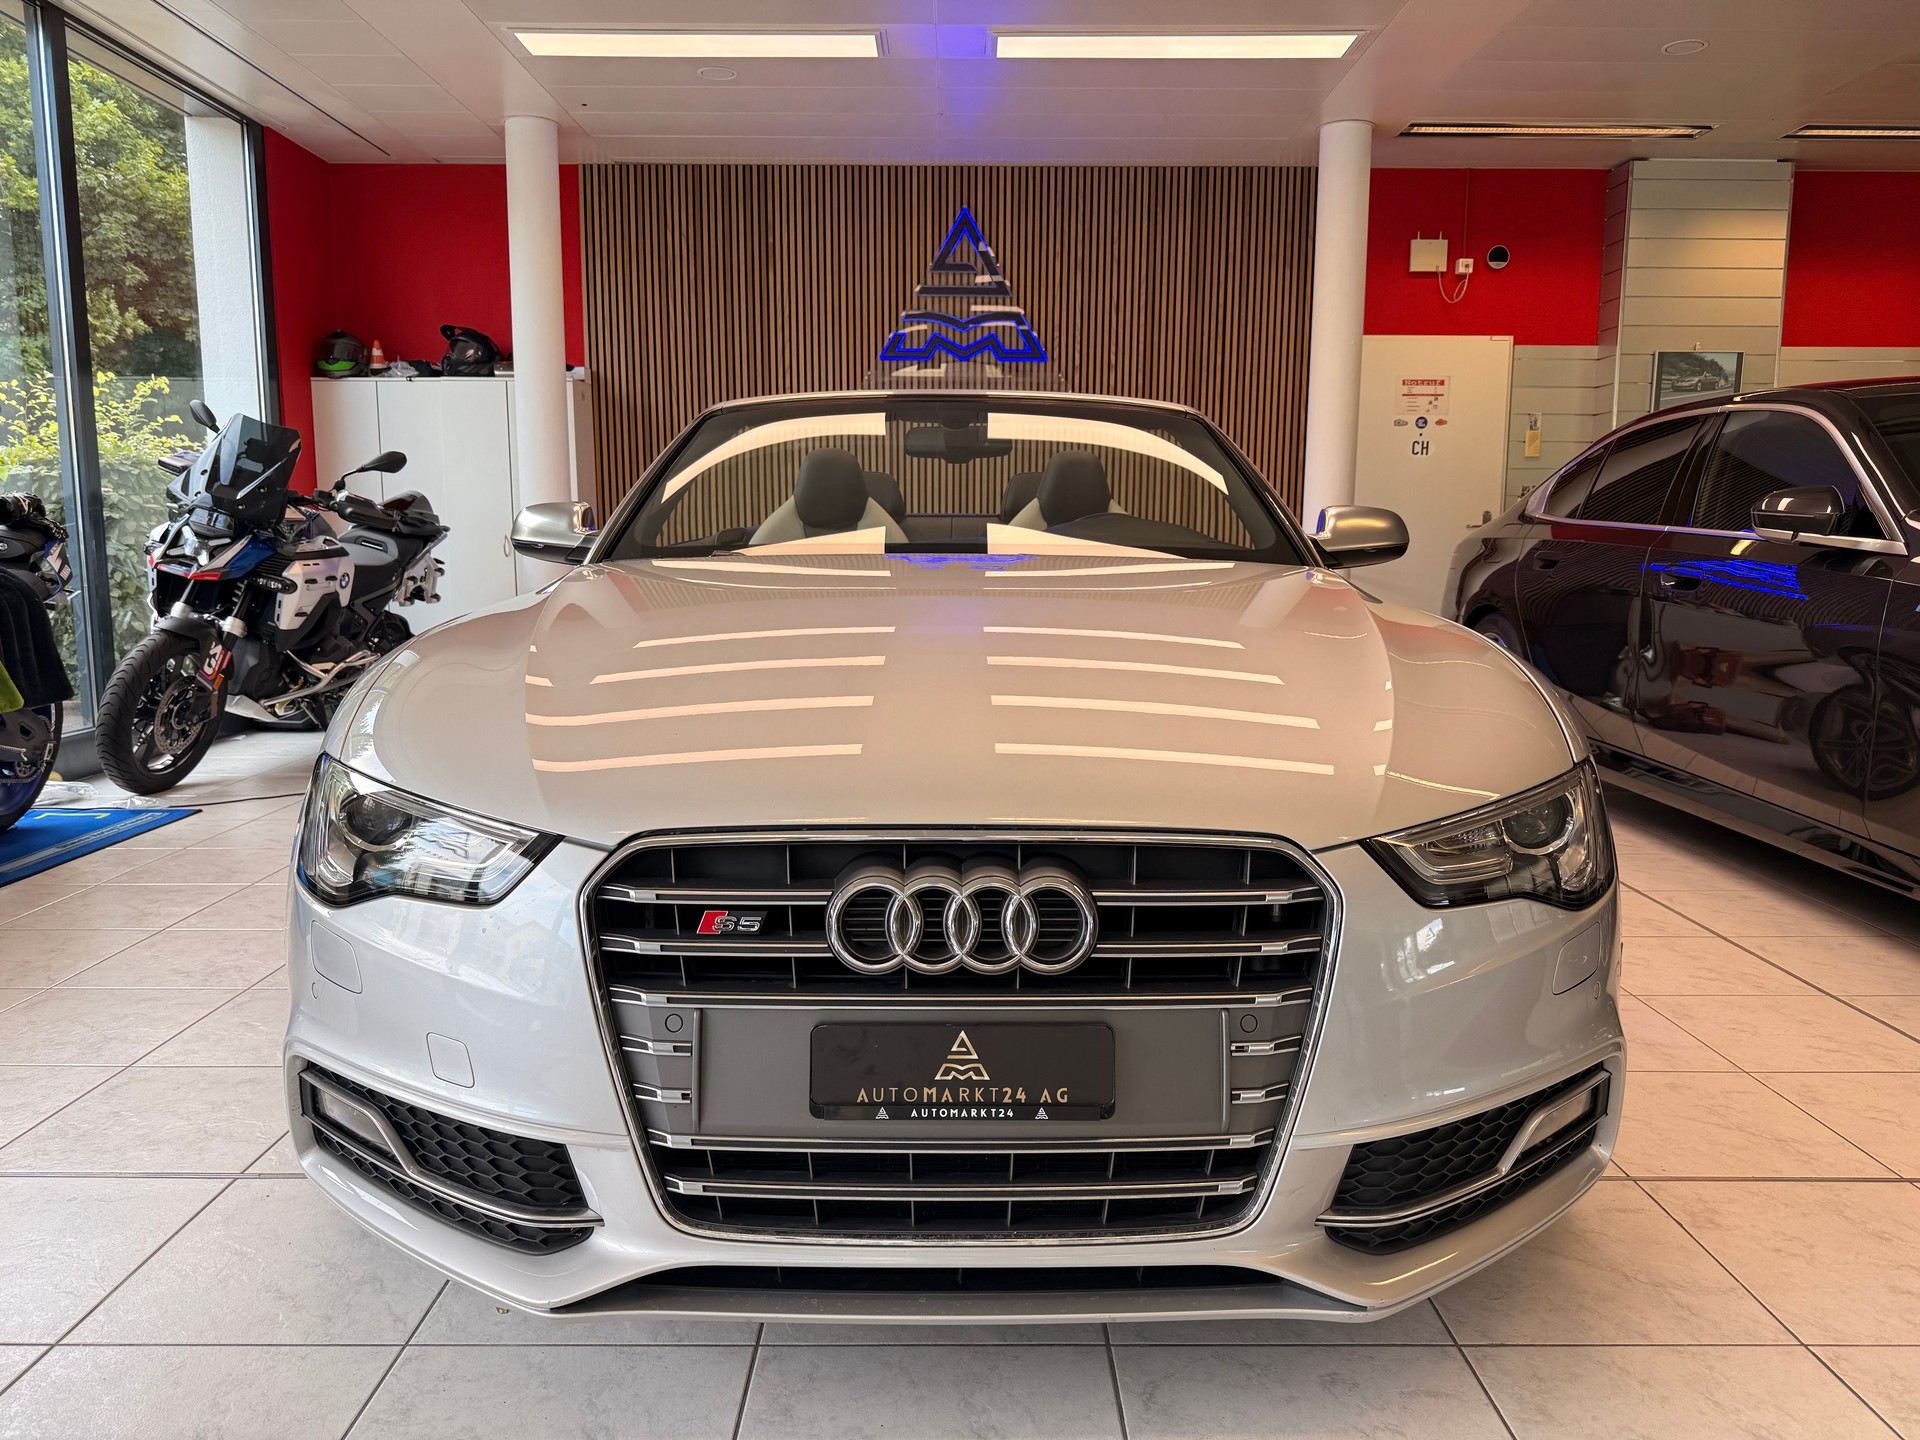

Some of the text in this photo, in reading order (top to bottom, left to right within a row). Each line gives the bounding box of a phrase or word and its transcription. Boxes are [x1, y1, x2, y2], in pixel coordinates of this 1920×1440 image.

[1412, 441, 1429, 455] CH
[203, 641, 223, 675] GS
[712, 916, 762, 932] S5
[856, 1087, 1068, 1103] AUTOMARKT24 AG
[911, 1108, 1014, 1117] AUTOMARKT24
